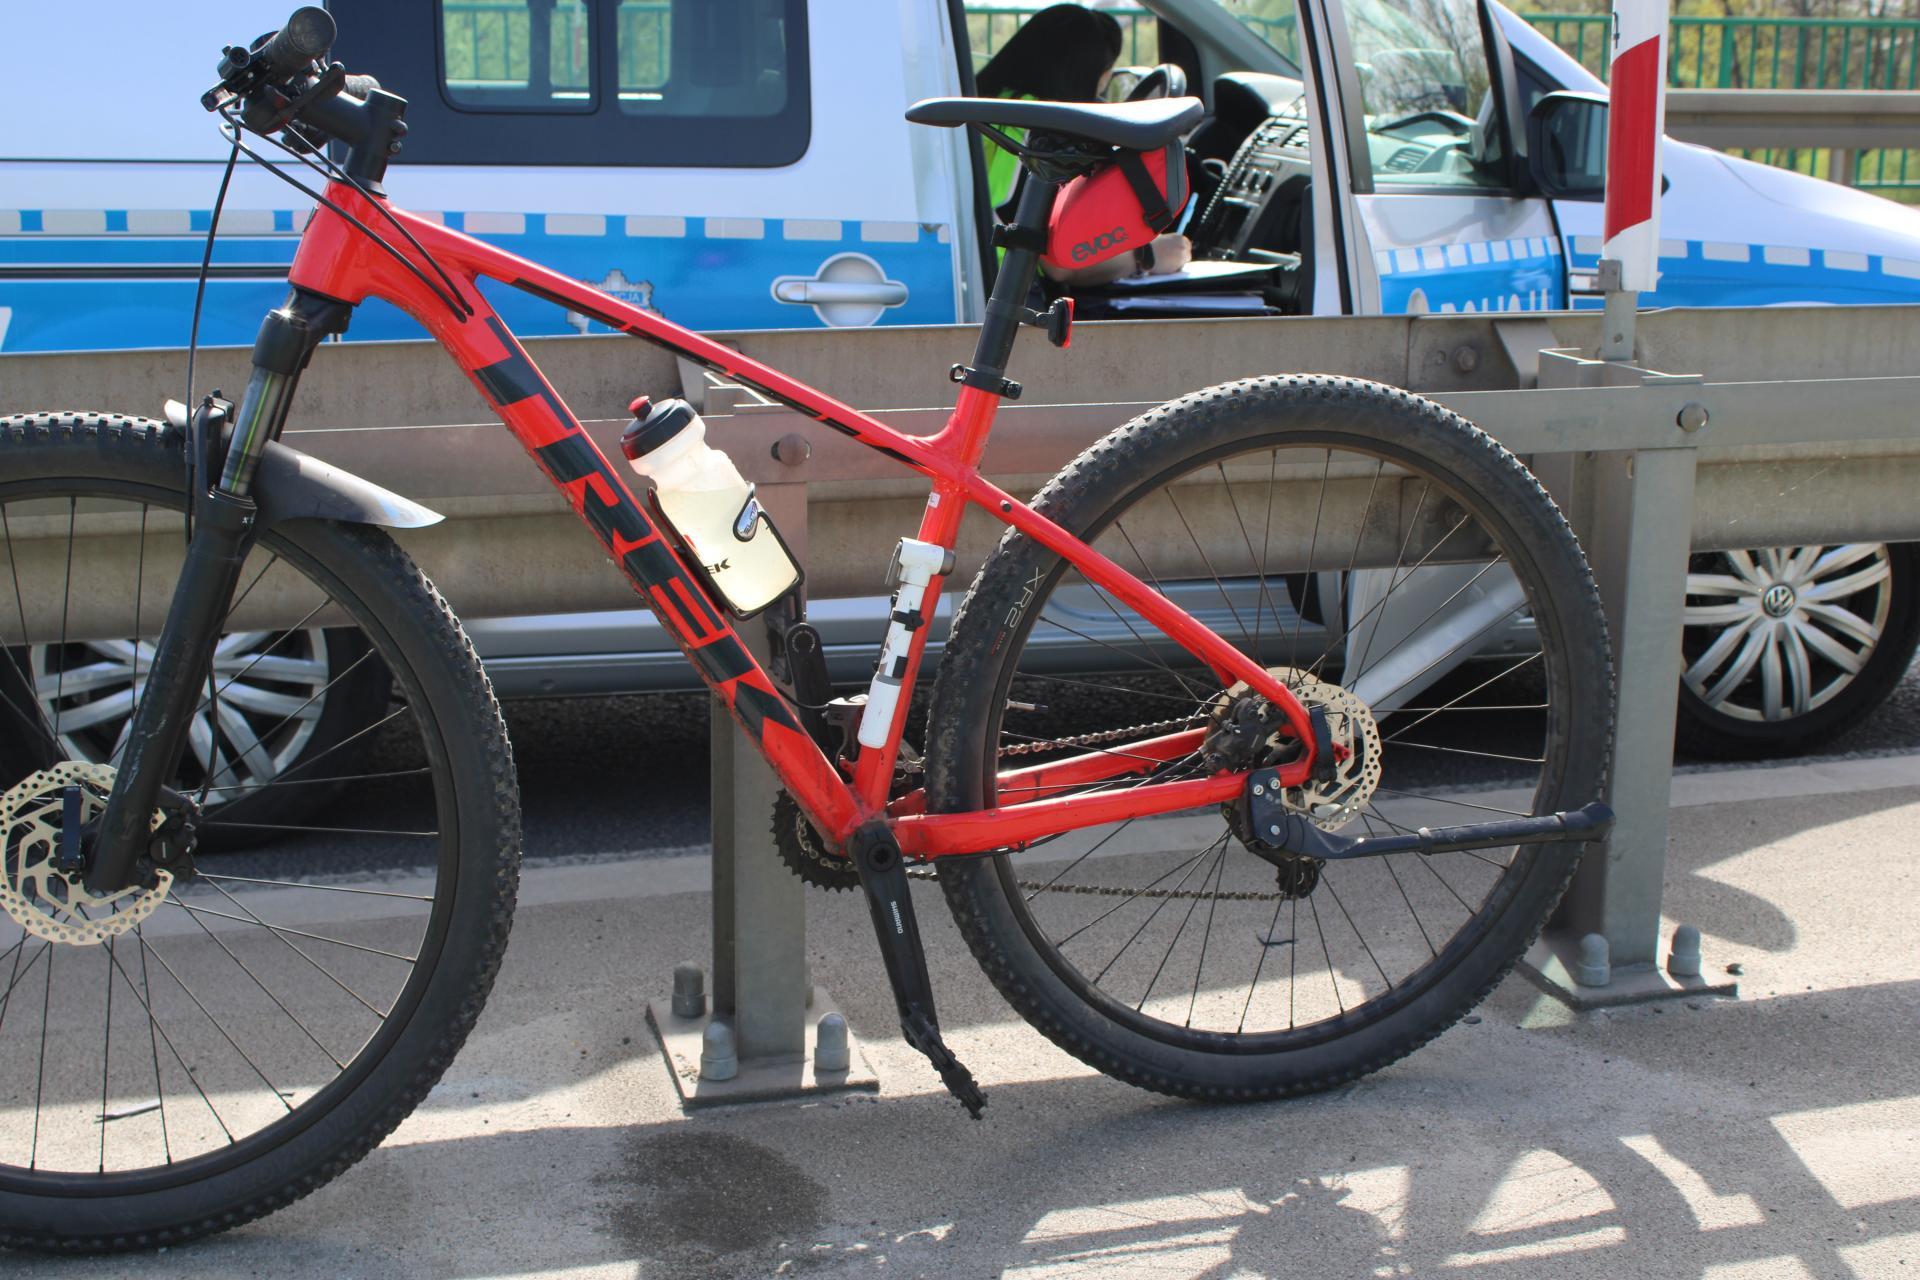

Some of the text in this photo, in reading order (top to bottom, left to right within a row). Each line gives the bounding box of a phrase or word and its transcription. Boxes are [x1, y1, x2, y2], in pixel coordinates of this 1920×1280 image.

[473, 315, 806, 746] TREK
[705, 558, 731, 575] EK
[1004, 567, 1046, 628] XR2
